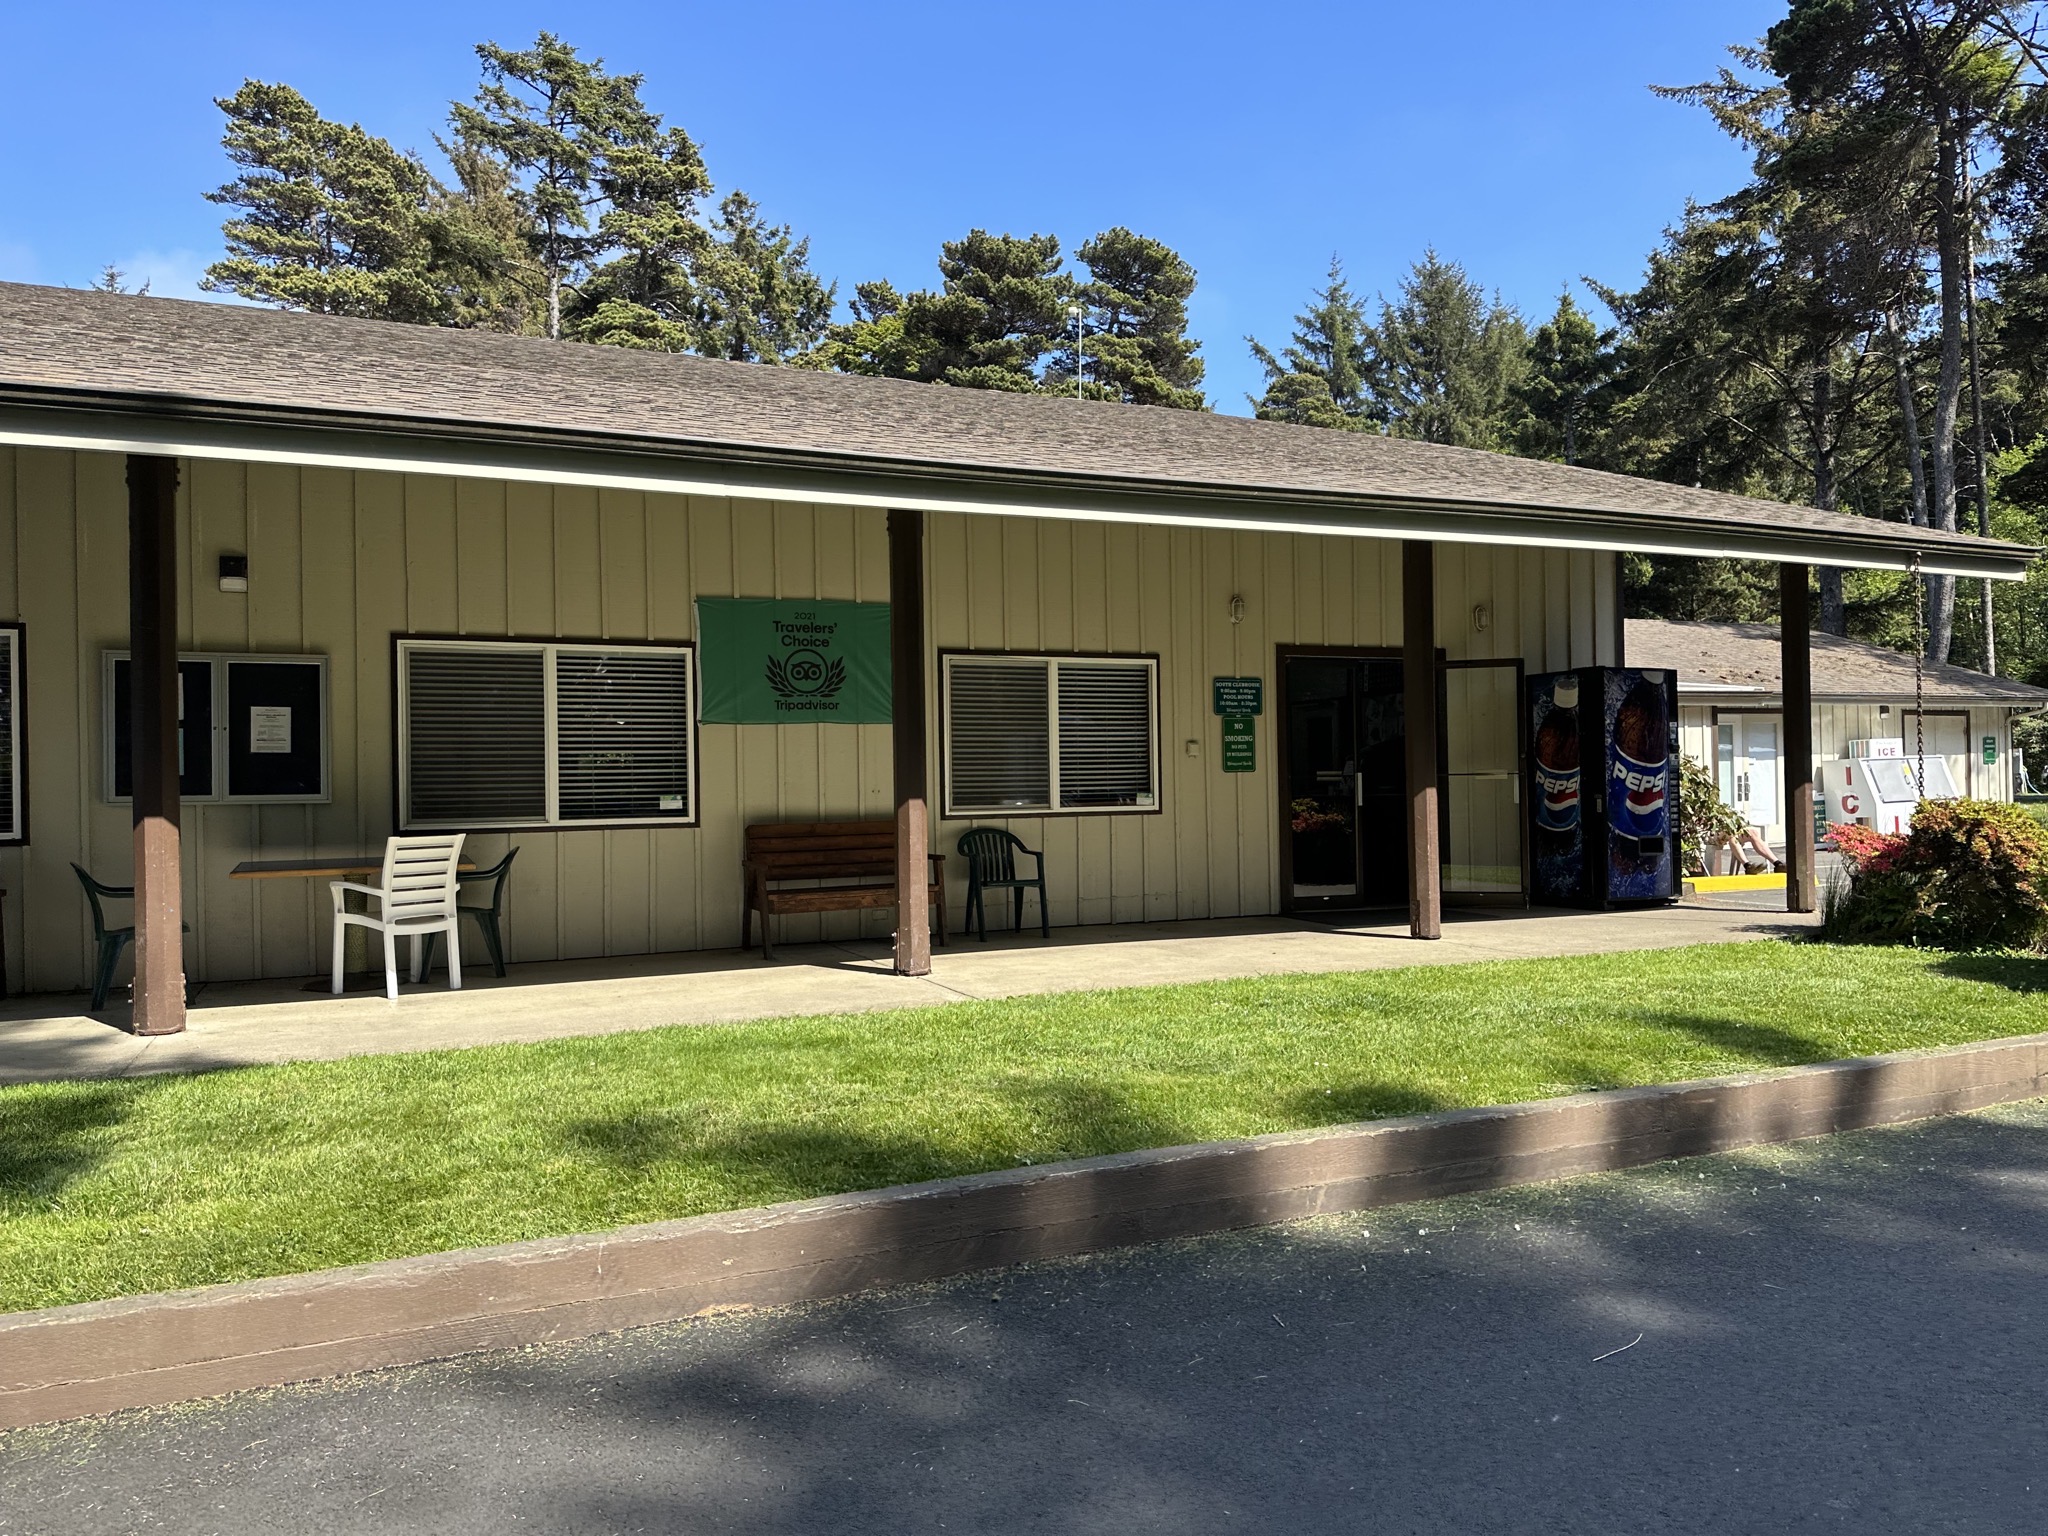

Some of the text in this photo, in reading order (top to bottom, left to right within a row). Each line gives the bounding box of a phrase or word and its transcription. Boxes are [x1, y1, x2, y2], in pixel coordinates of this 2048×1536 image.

[794, 612, 816, 620] 2021
[781, 635, 830, 648] Choice
[774, 700, 840, 712] Tripadvisor
[1878, 747, 1896, 757] ICE
